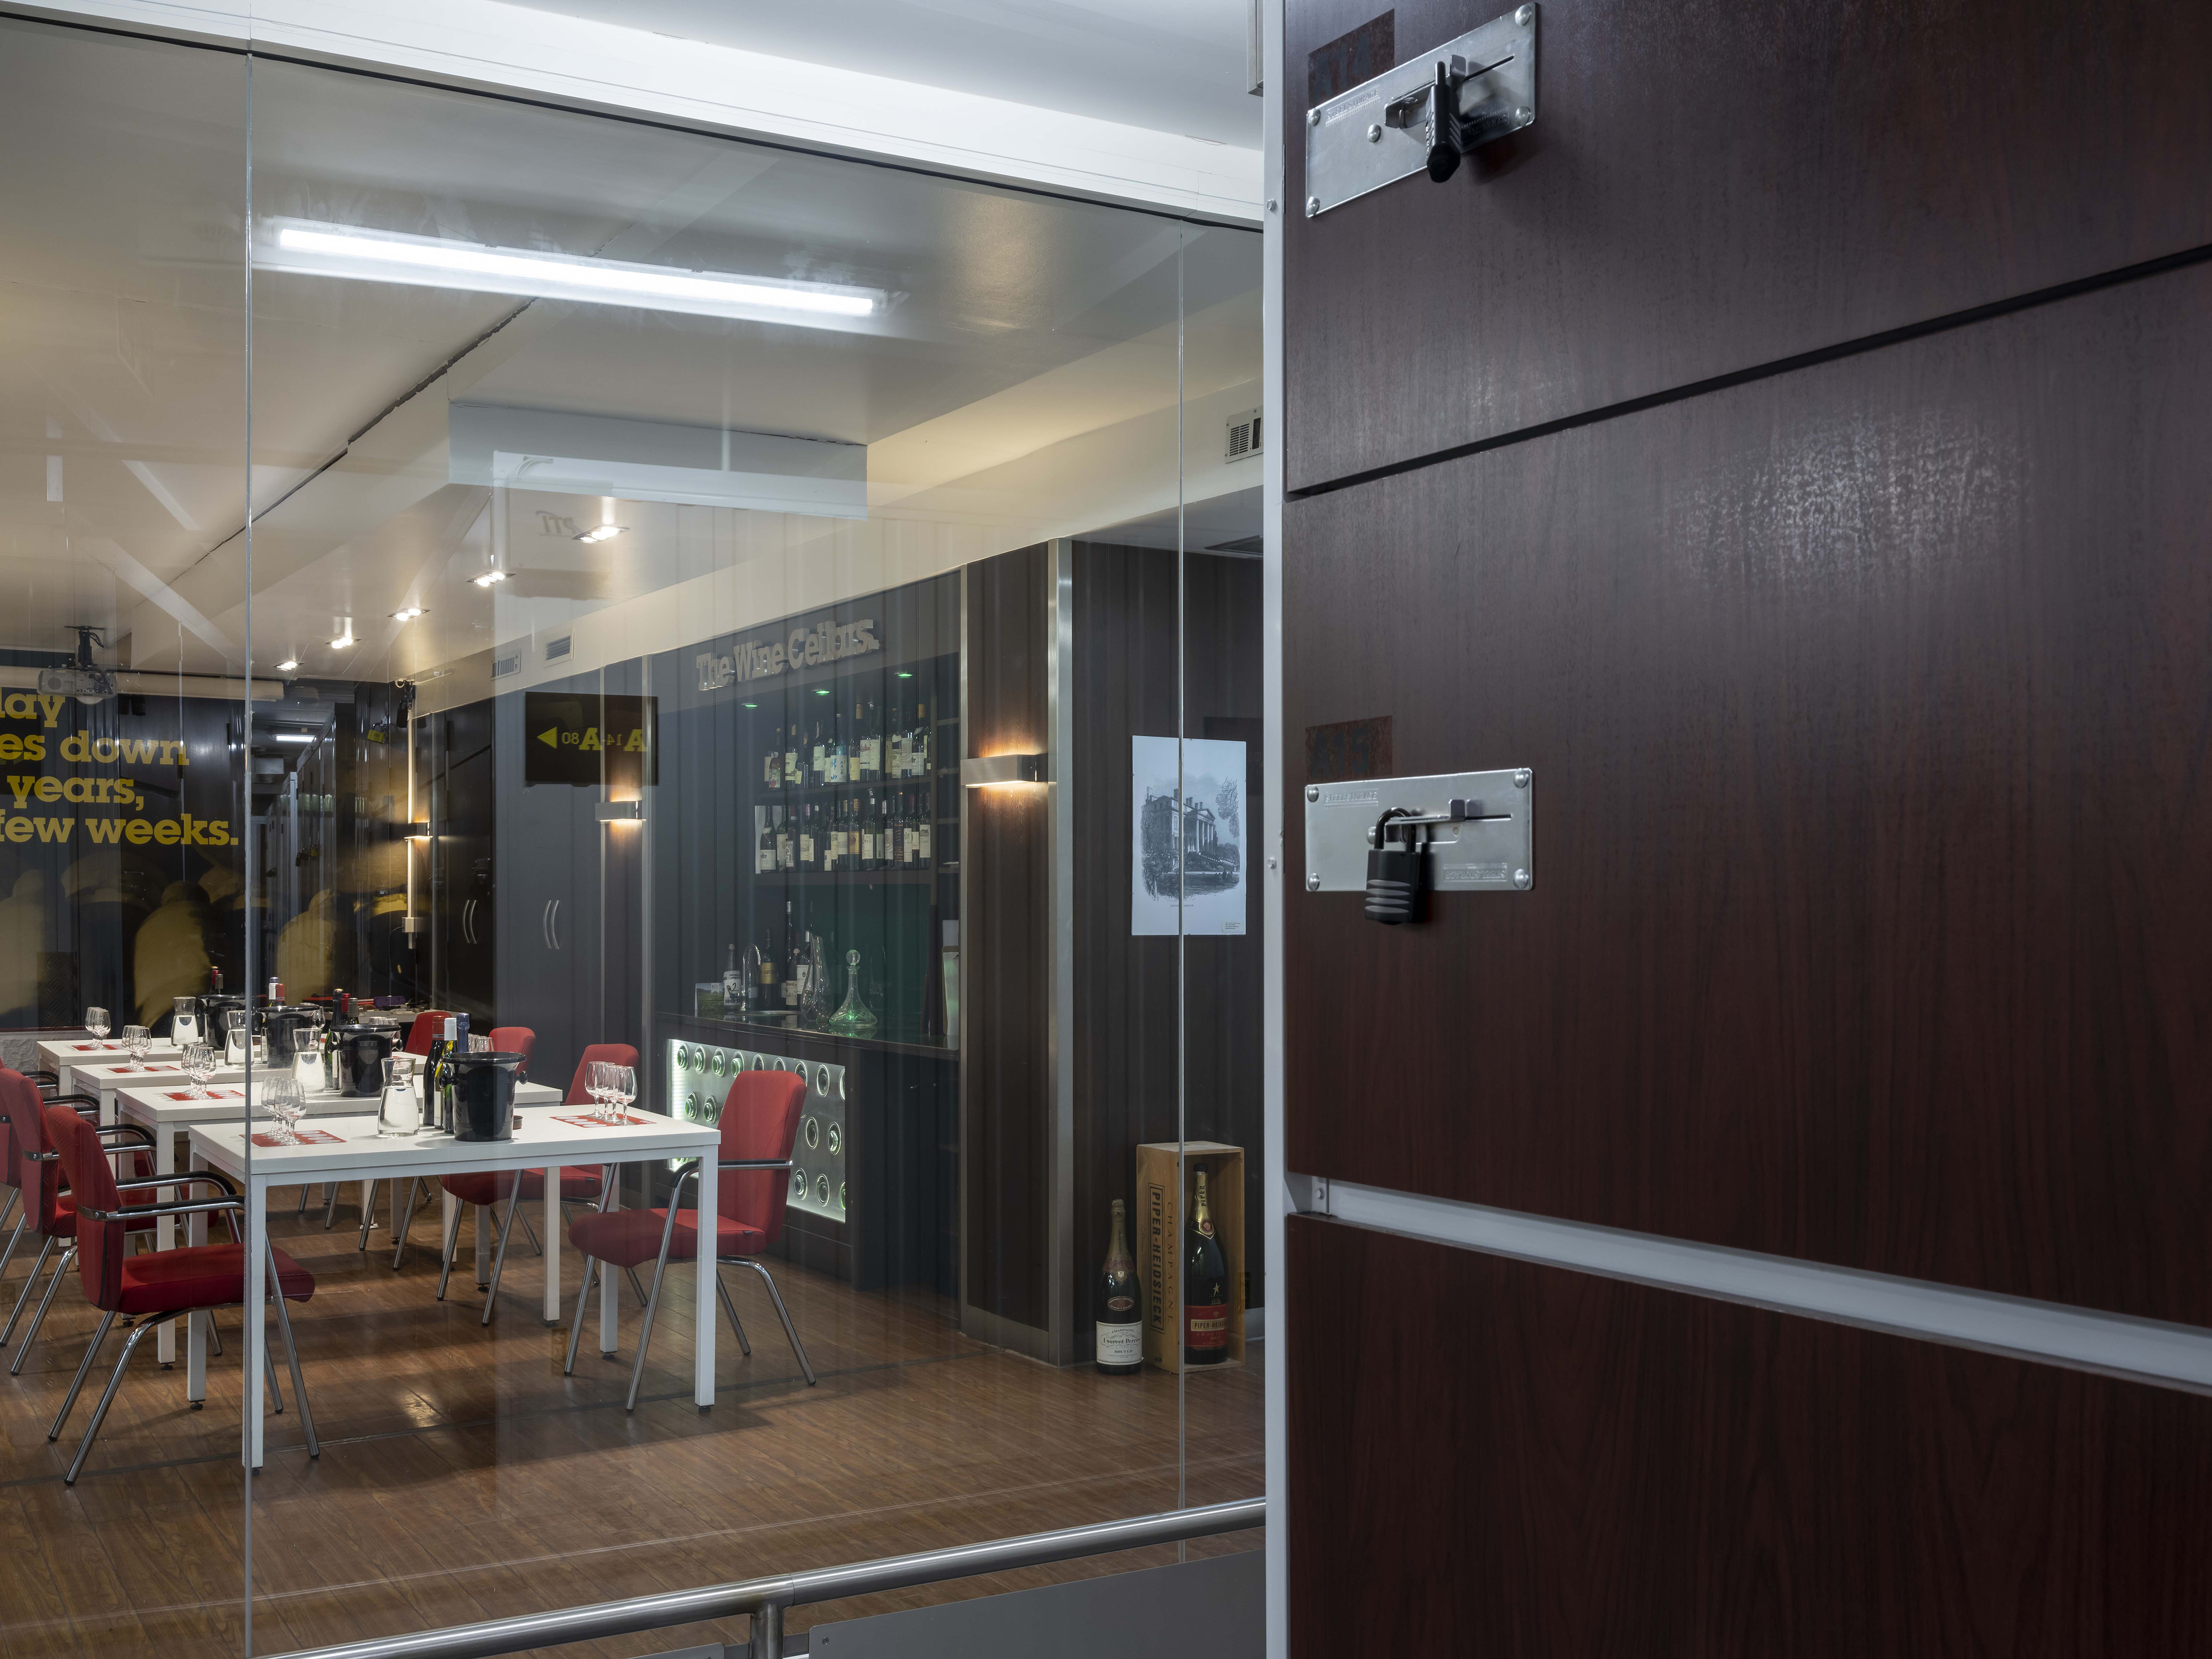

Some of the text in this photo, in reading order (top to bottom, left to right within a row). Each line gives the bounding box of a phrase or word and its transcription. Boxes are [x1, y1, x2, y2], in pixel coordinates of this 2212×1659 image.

[696, 652, 735, 691] The
[734, 640, 789, 682] Wine
[0, 687, 65, 728] ay
[60, 730, 190, 766] down
[1310, 727, 1370, 780] A15
[7, 775, 144, 811] years,
[86, 813, 238, 846] weeks.
[1152, 1191, 1161, 1324] PIPER-HEIDSIECK
